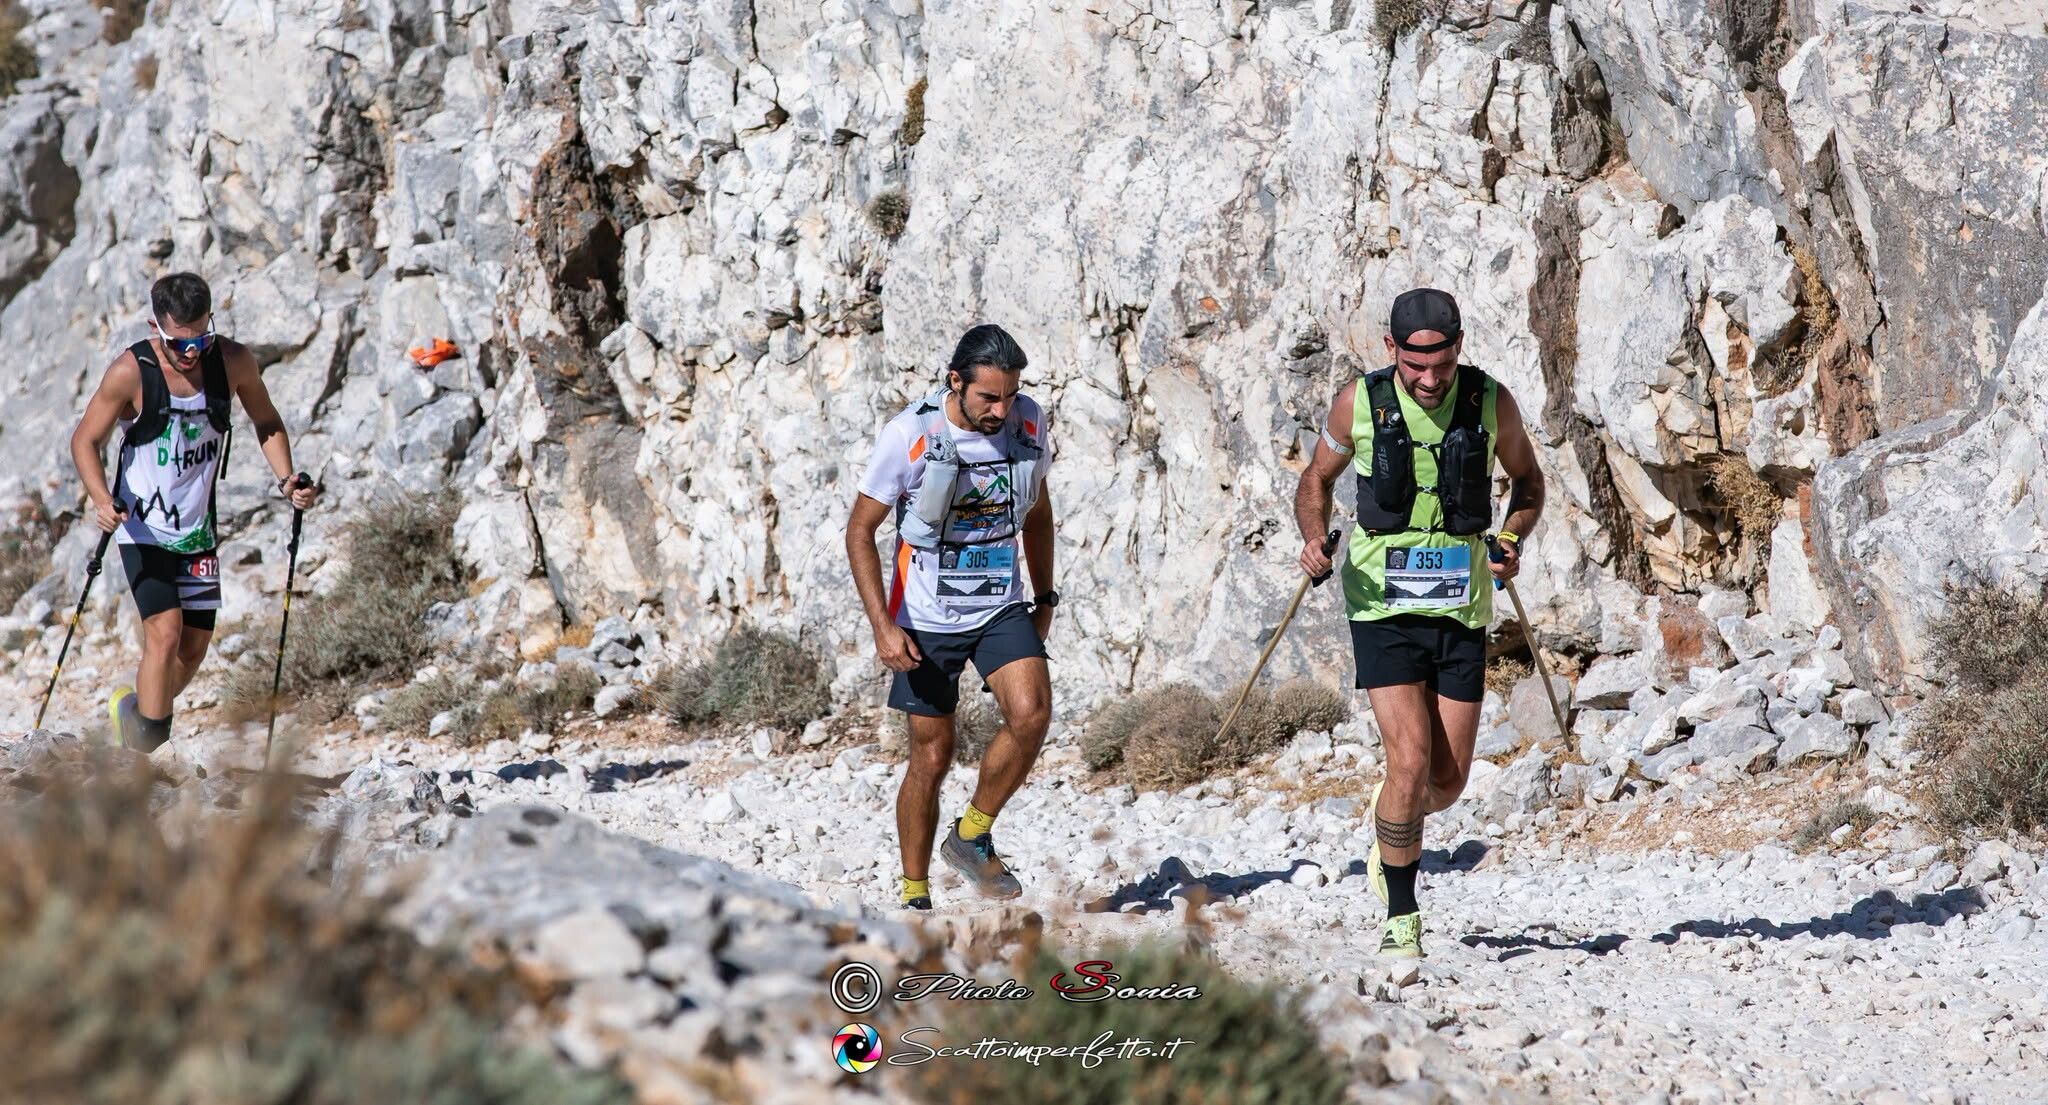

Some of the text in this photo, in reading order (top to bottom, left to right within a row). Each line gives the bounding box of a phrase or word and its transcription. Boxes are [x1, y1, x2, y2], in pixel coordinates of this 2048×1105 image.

[200, 559, 218, 577] 512
[966, 551, 989, 569] 305
[1415, 551, 1444, 570] 353
